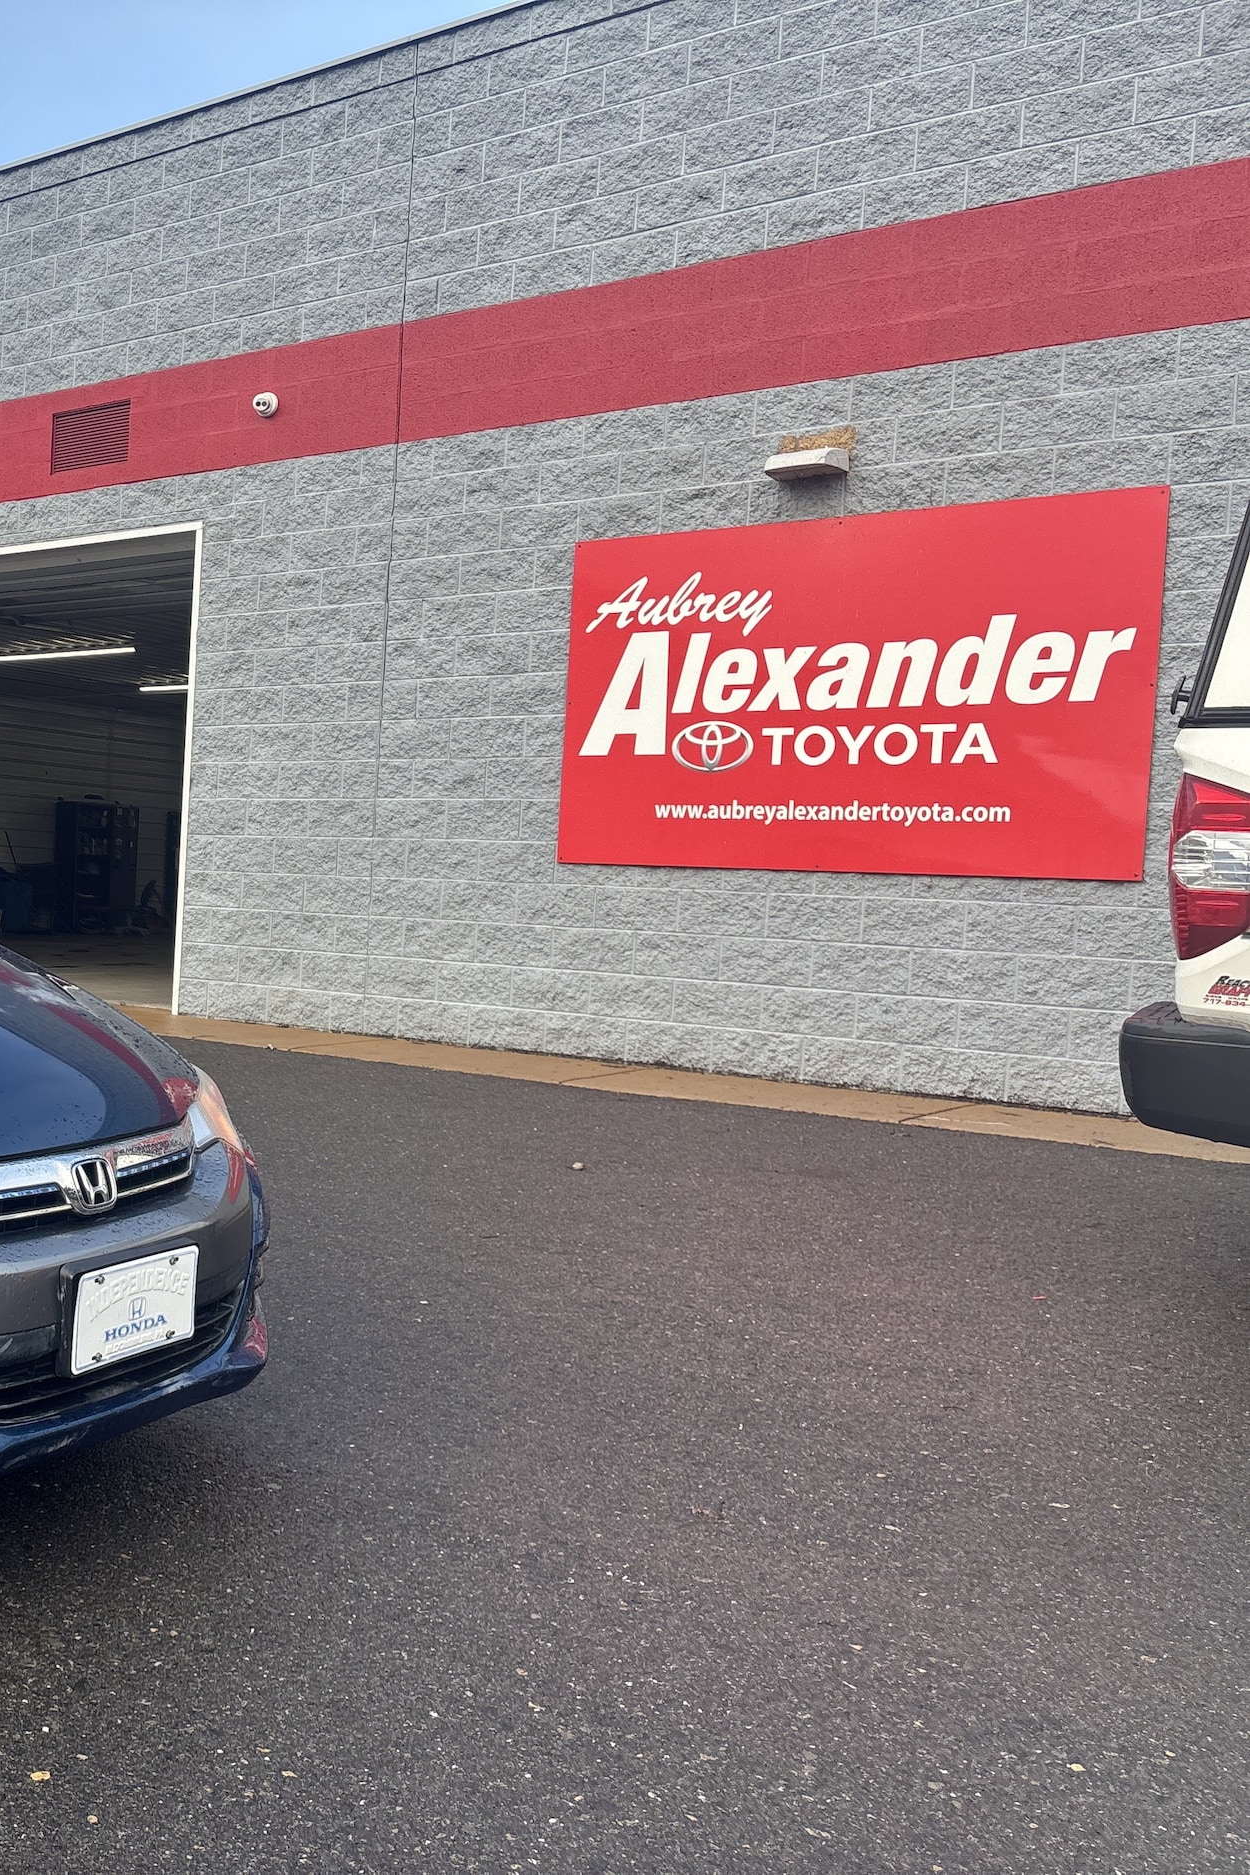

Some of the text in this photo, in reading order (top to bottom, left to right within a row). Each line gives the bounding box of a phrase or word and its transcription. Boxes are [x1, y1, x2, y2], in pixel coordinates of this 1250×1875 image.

[585, 571, 773, 637] Aubrey
[578, 613, 1137, 757] Alexander
[762, 722, 998, 766] TOYOTA
[654, 799, 1011, 827] www.aubreyalexandertoyota.com
[85, 1267, 190, 1323] INDEPENDENCE
[103, 1314, 168, 1343] HONDA
